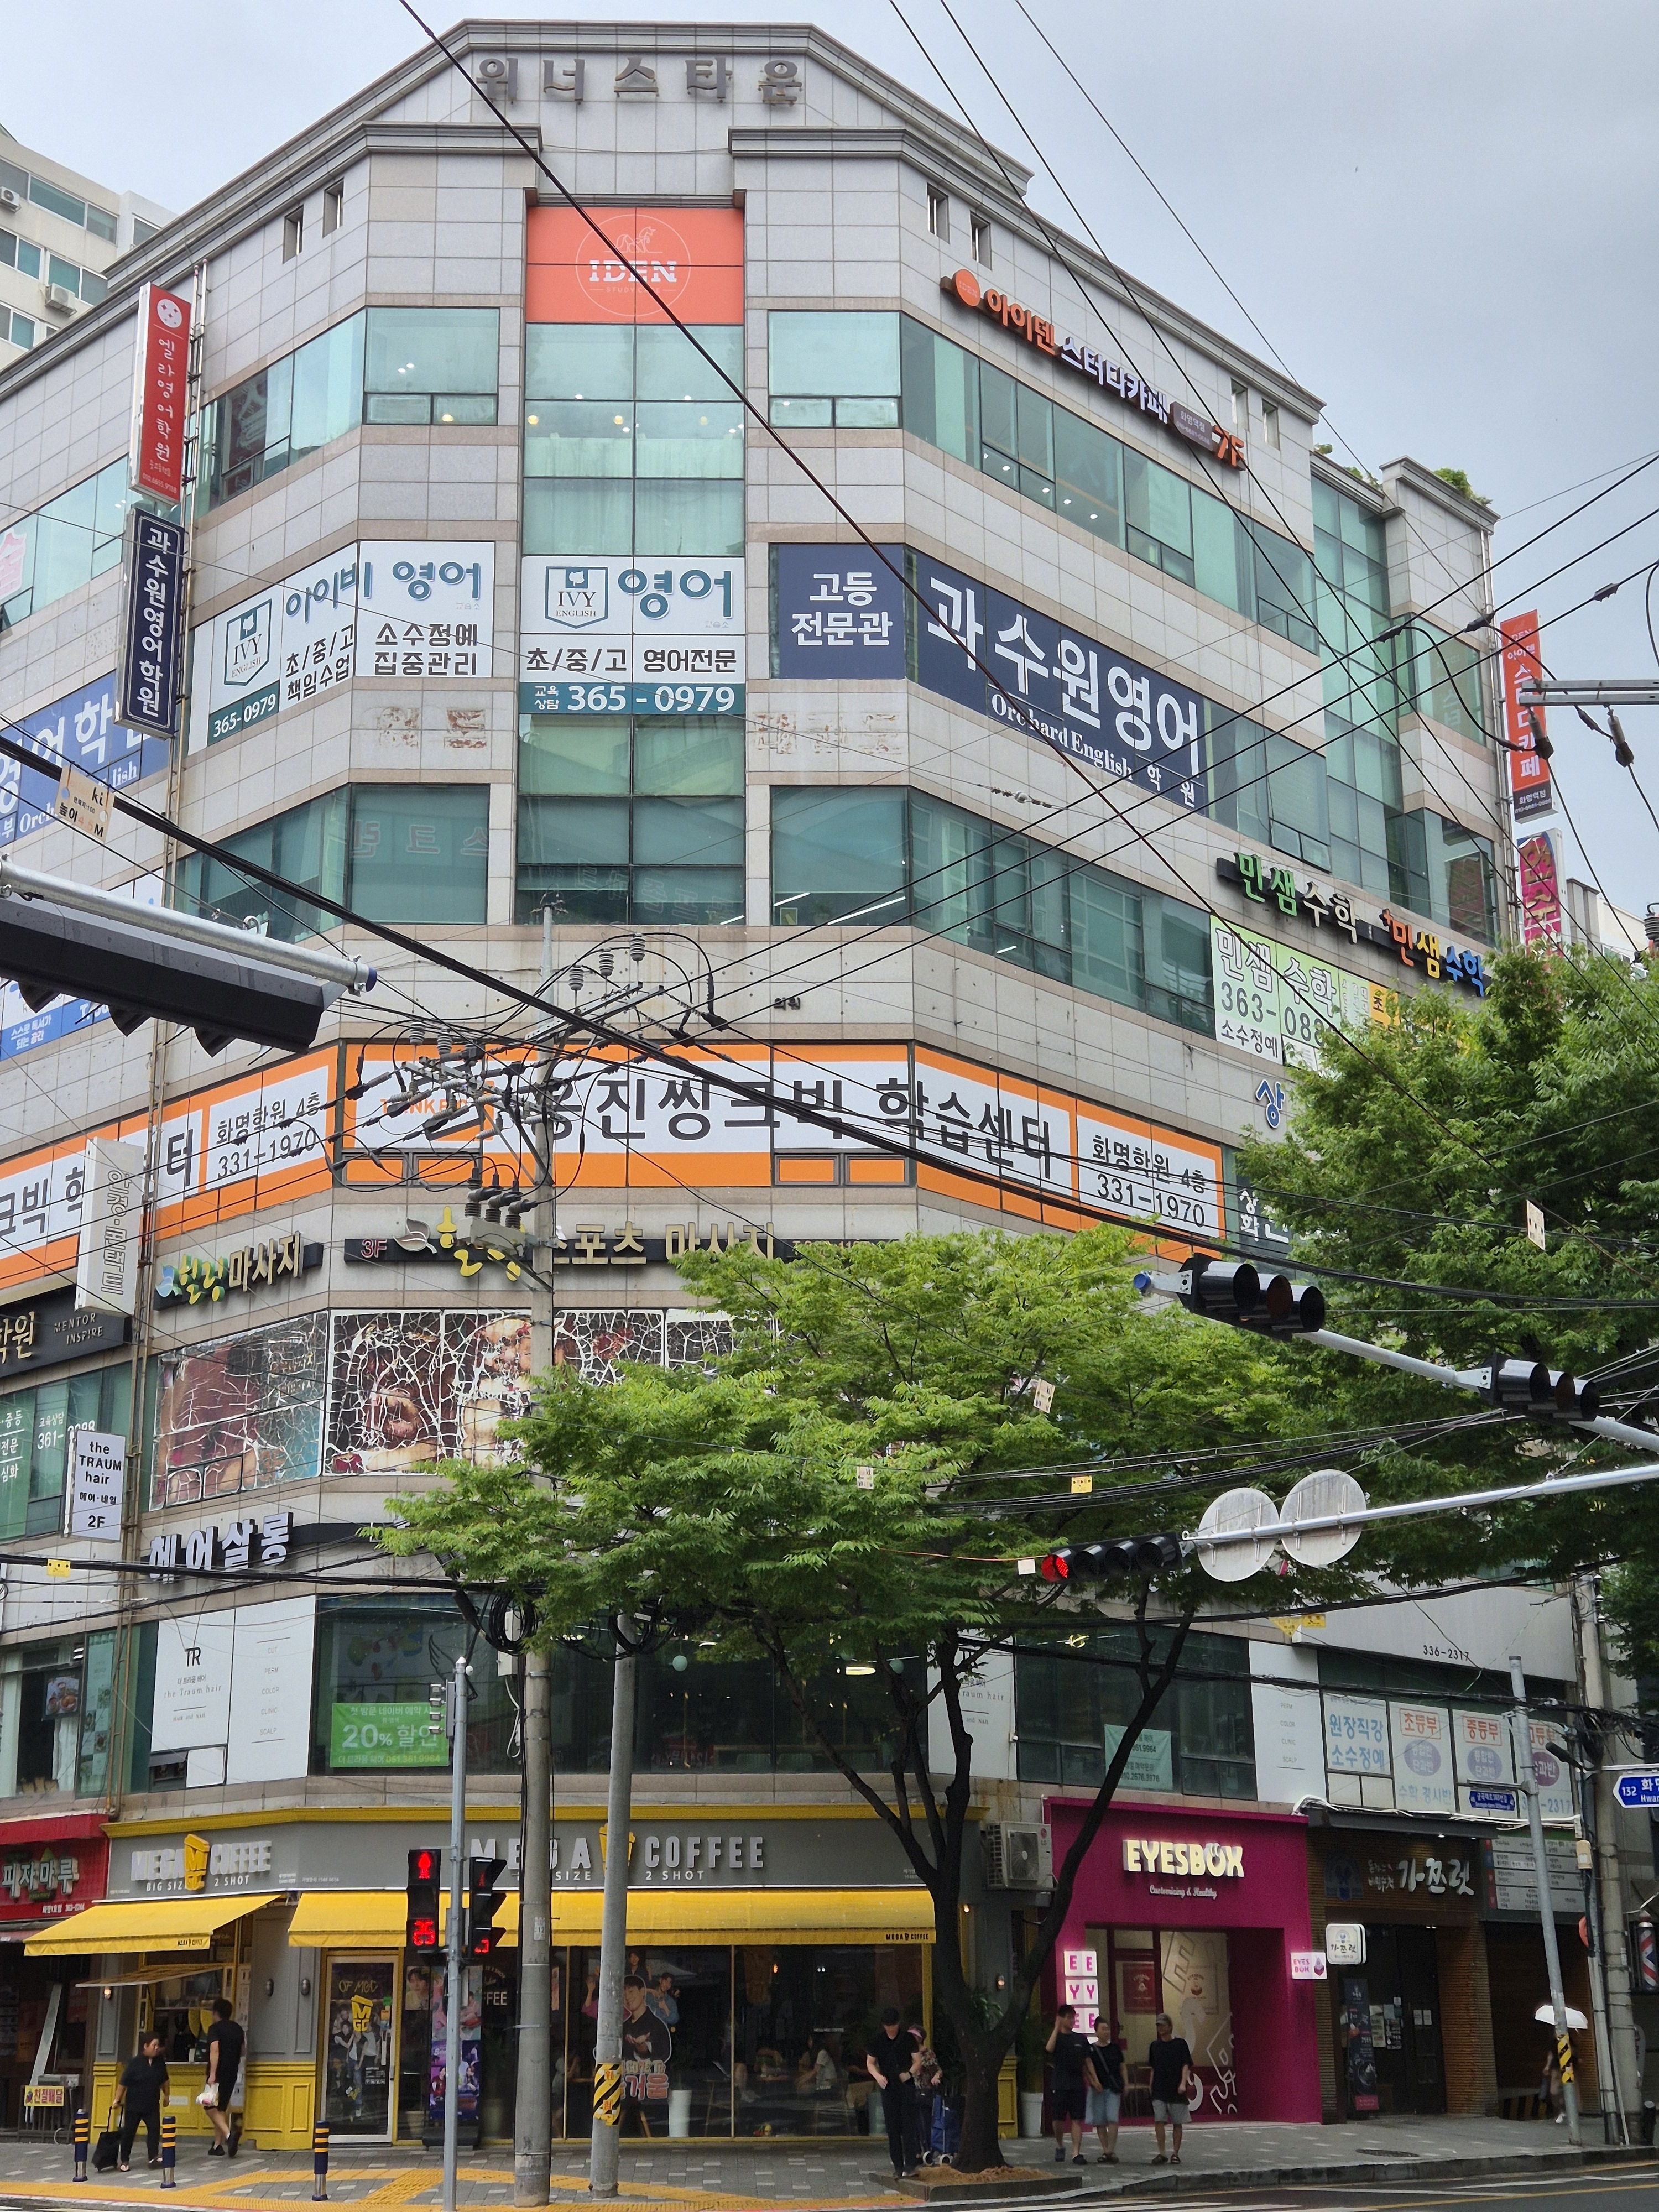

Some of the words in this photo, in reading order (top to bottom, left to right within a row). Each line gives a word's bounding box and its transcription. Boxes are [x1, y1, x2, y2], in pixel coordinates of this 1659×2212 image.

[476, 56, 802, 105] 위너스타운
[589, 260, 677, 282] IDEN
[984, 288, 1056, 355] 아이덴
[1061, 336, 1168, 424] 스터디카페
[155, 338, 176, 462] 엘라영어학원
[1213, 424, 1244, 467] 7F
[286, 561, 371, 624] 아이비
[392, 561, 481, 599] 영어
[556, 591, 597, 607] IVY
[618, 569, 733, 619] 영어
[810, 572, 877, 606] 고등
[375, 623, 478, 647] 소수정예
[791, 612, 893, 646] 전문관
[233, 634, 262, 665] IVY
[644, 649, 737, 673] 영어전문
[231, 656, 261, 679] ENGLISH
[374, 653, 477, 676] 집중관리
[927, 576, 1198, 776] 과수원영어
[286, 654, 349, 702] 책임수업
[534, 685, 559, 697] 교육
[213, 693, 276, 738] 365-0979
[534, 699, 560, 710] 상담
[1283, 956, 1337, 1017] 수학
[1220, 1019, 1279, 1059] 소수정예
[216, 1098, 286, 1145] 화명학원
[876, 1077, 1051, 1180] 학습센터
[217, 1126, 316, 1180] 331-1970
[1093, 1133, 1170, 1181] 화명학원
[1181, 1168, 1206, 1196] 4층
[1097, 1173, 1205, 1228] 331-1970
[361, 1238, 387, 1259] 3F
[229, 1231, 301, 1292] 마사지
[54, 1313, 96, 1333] MENTOR
[66, 1326, 104, 1345] INSPIRE
[39, 1412, 65, 1428] 교육상담
[1, 1438, 19, 1456] 전문
[89, 1441, 110, 1455] the
[1, 1463, 19, 1483] 심화
[79, 1455, 122, 1472] TRAUM
[85, 1471, 110, 1485] hair
[87, 1515, 106, 1528] 2F
[149, 1512, 291, 1583] 헤어살롱
[185, 1647, 201, 1667] TR
[1423, 1644, 1470, 1661] 336-2317
[180, 1688, 202, 1697] Traum
[206, 1684, 222, 1693] hair
[262, 1687, 280, 1695] COLOR
[987, 1691, 1004, 1701] hair
[261, 1707, 278, 1715] CLINIC
[379, 1706, 403, 1715] 네이버
[259, 1727, 277, 1736] SCALP
[1329, 1713, 1384, 1743] 원장직강
[1404, 1712, 1437, 1735] 초등부
[1467, 1720, 1499, 1741] 중등부
[342, 1724, 393, 1748] 20%
[397, 1724, 438, 1747] 할인
[1332, 1744, 1385, 1772] 소수정예
[1621, 1786, 1637, 1796] 132
[132, 1848, 186, 1881] MEGA
[210, 1840, 273, 1876] COFFEE
[645, 1835, 764, 1869] COFFEE
[1126, 1839, 1245, 1877] EYESBOX
[2, 1858, 78, 1899] 피자마루
[146, 1881, 163, 1892] BIG
[167, 1880, 186, 1891] SIZ
[215, 1877, 219, 1887] 2
[224, 1875, 249, 1886] SHOT
[555, 1871, 591, 1881] SIZE
[646, 1871, 653, 1880] 2
[662, 1870, 705, 1881] SHOT
[33, 2088, 64, 2104] 친절배달
[620, 2073, 670, 2100] 거움
